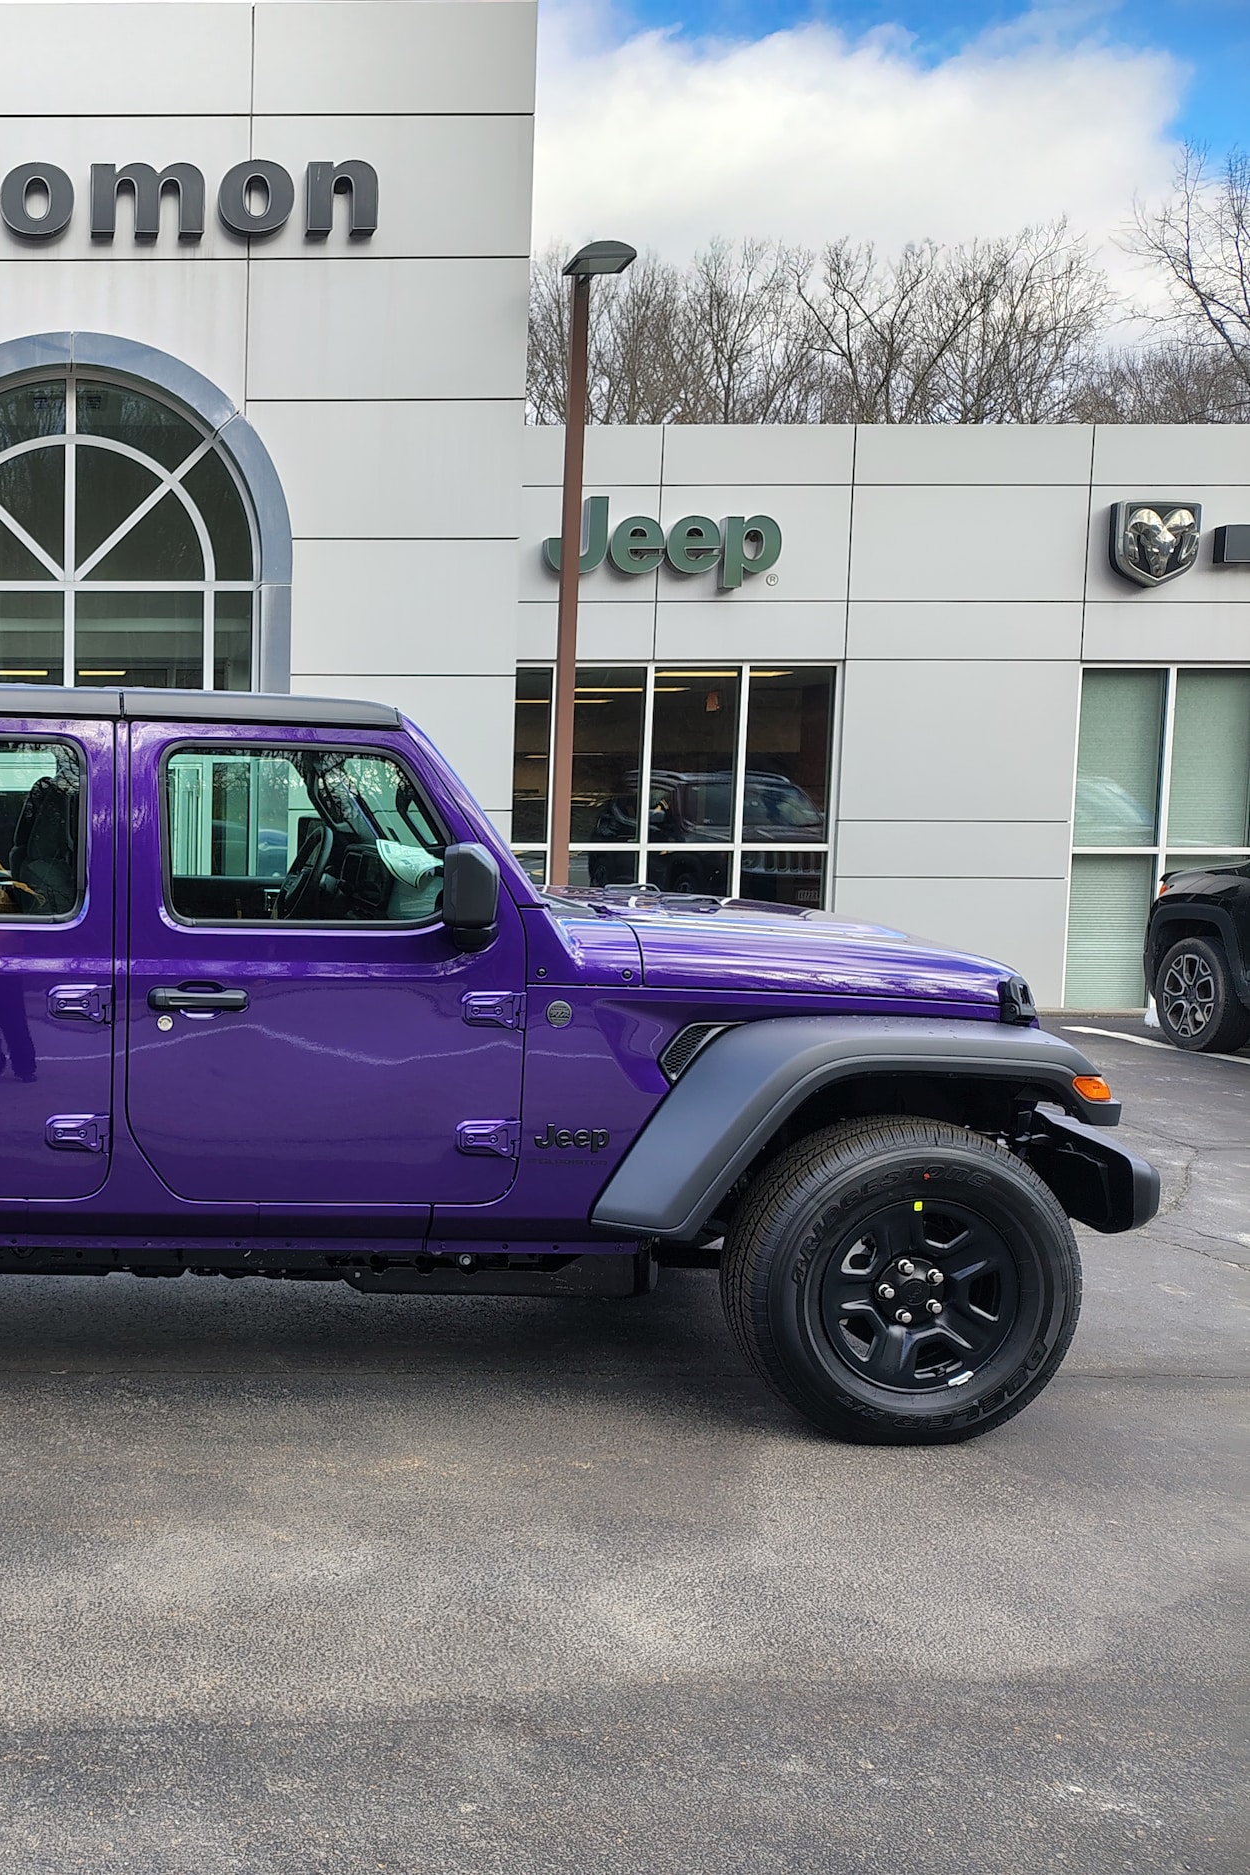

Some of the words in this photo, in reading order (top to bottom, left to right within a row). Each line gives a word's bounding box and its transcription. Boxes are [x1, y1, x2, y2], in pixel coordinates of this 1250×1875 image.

[542, 495, 783, 591] Jeep
[533, 1122, 611, 1154] Jeep
[791, 1163, 993, 1287] BRIDGESTONE
[892, 1336, 1049, 1430] DUELER
